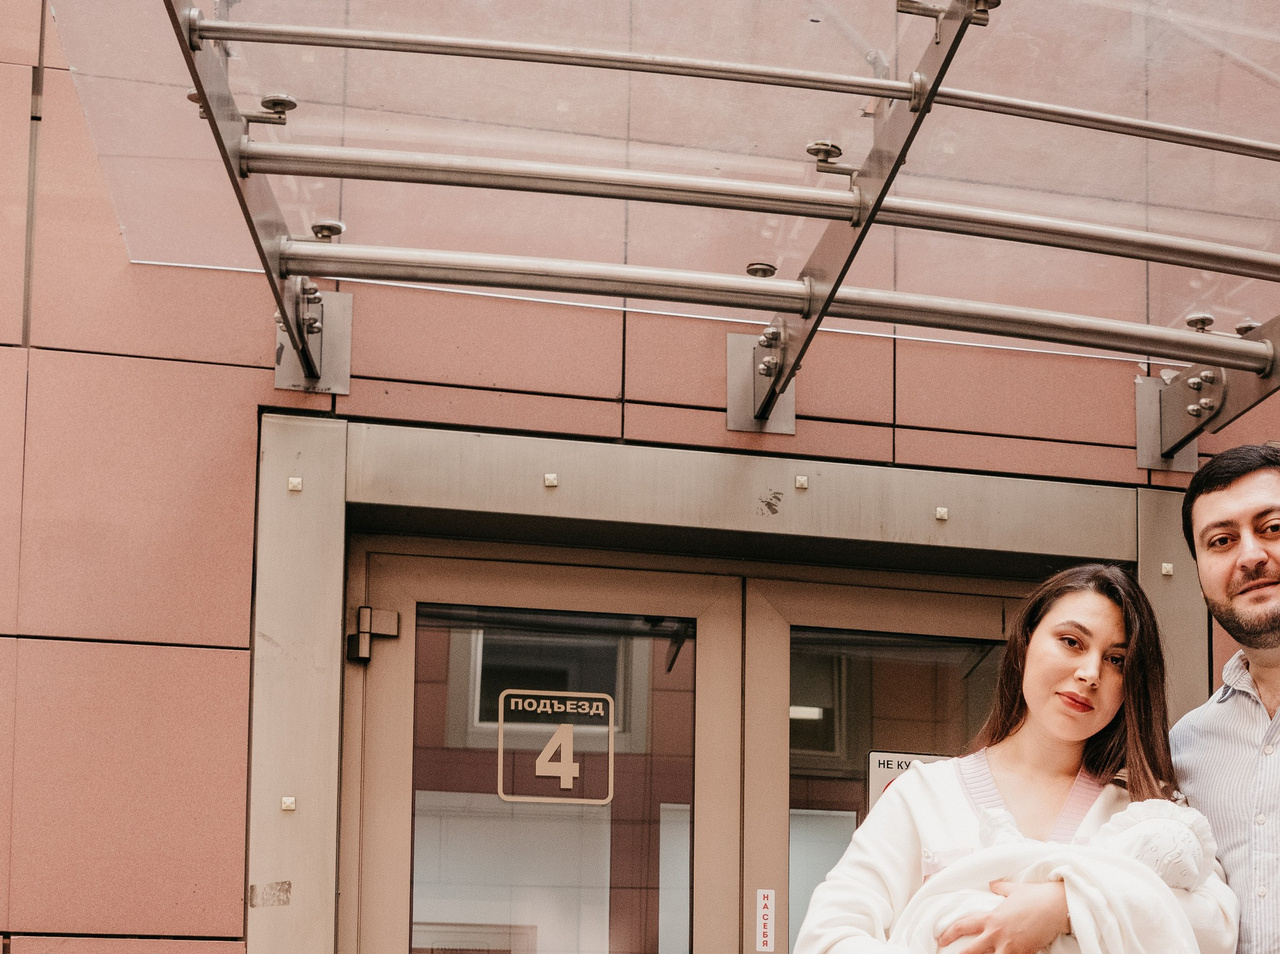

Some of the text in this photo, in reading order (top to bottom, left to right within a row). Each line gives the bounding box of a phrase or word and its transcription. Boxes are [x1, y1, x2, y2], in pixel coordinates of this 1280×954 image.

[510, 698, 605, 716] ПОДЪЕЗД
[535, 723, 580, 790] 4
[878, 759, 893, 769] НЕ
